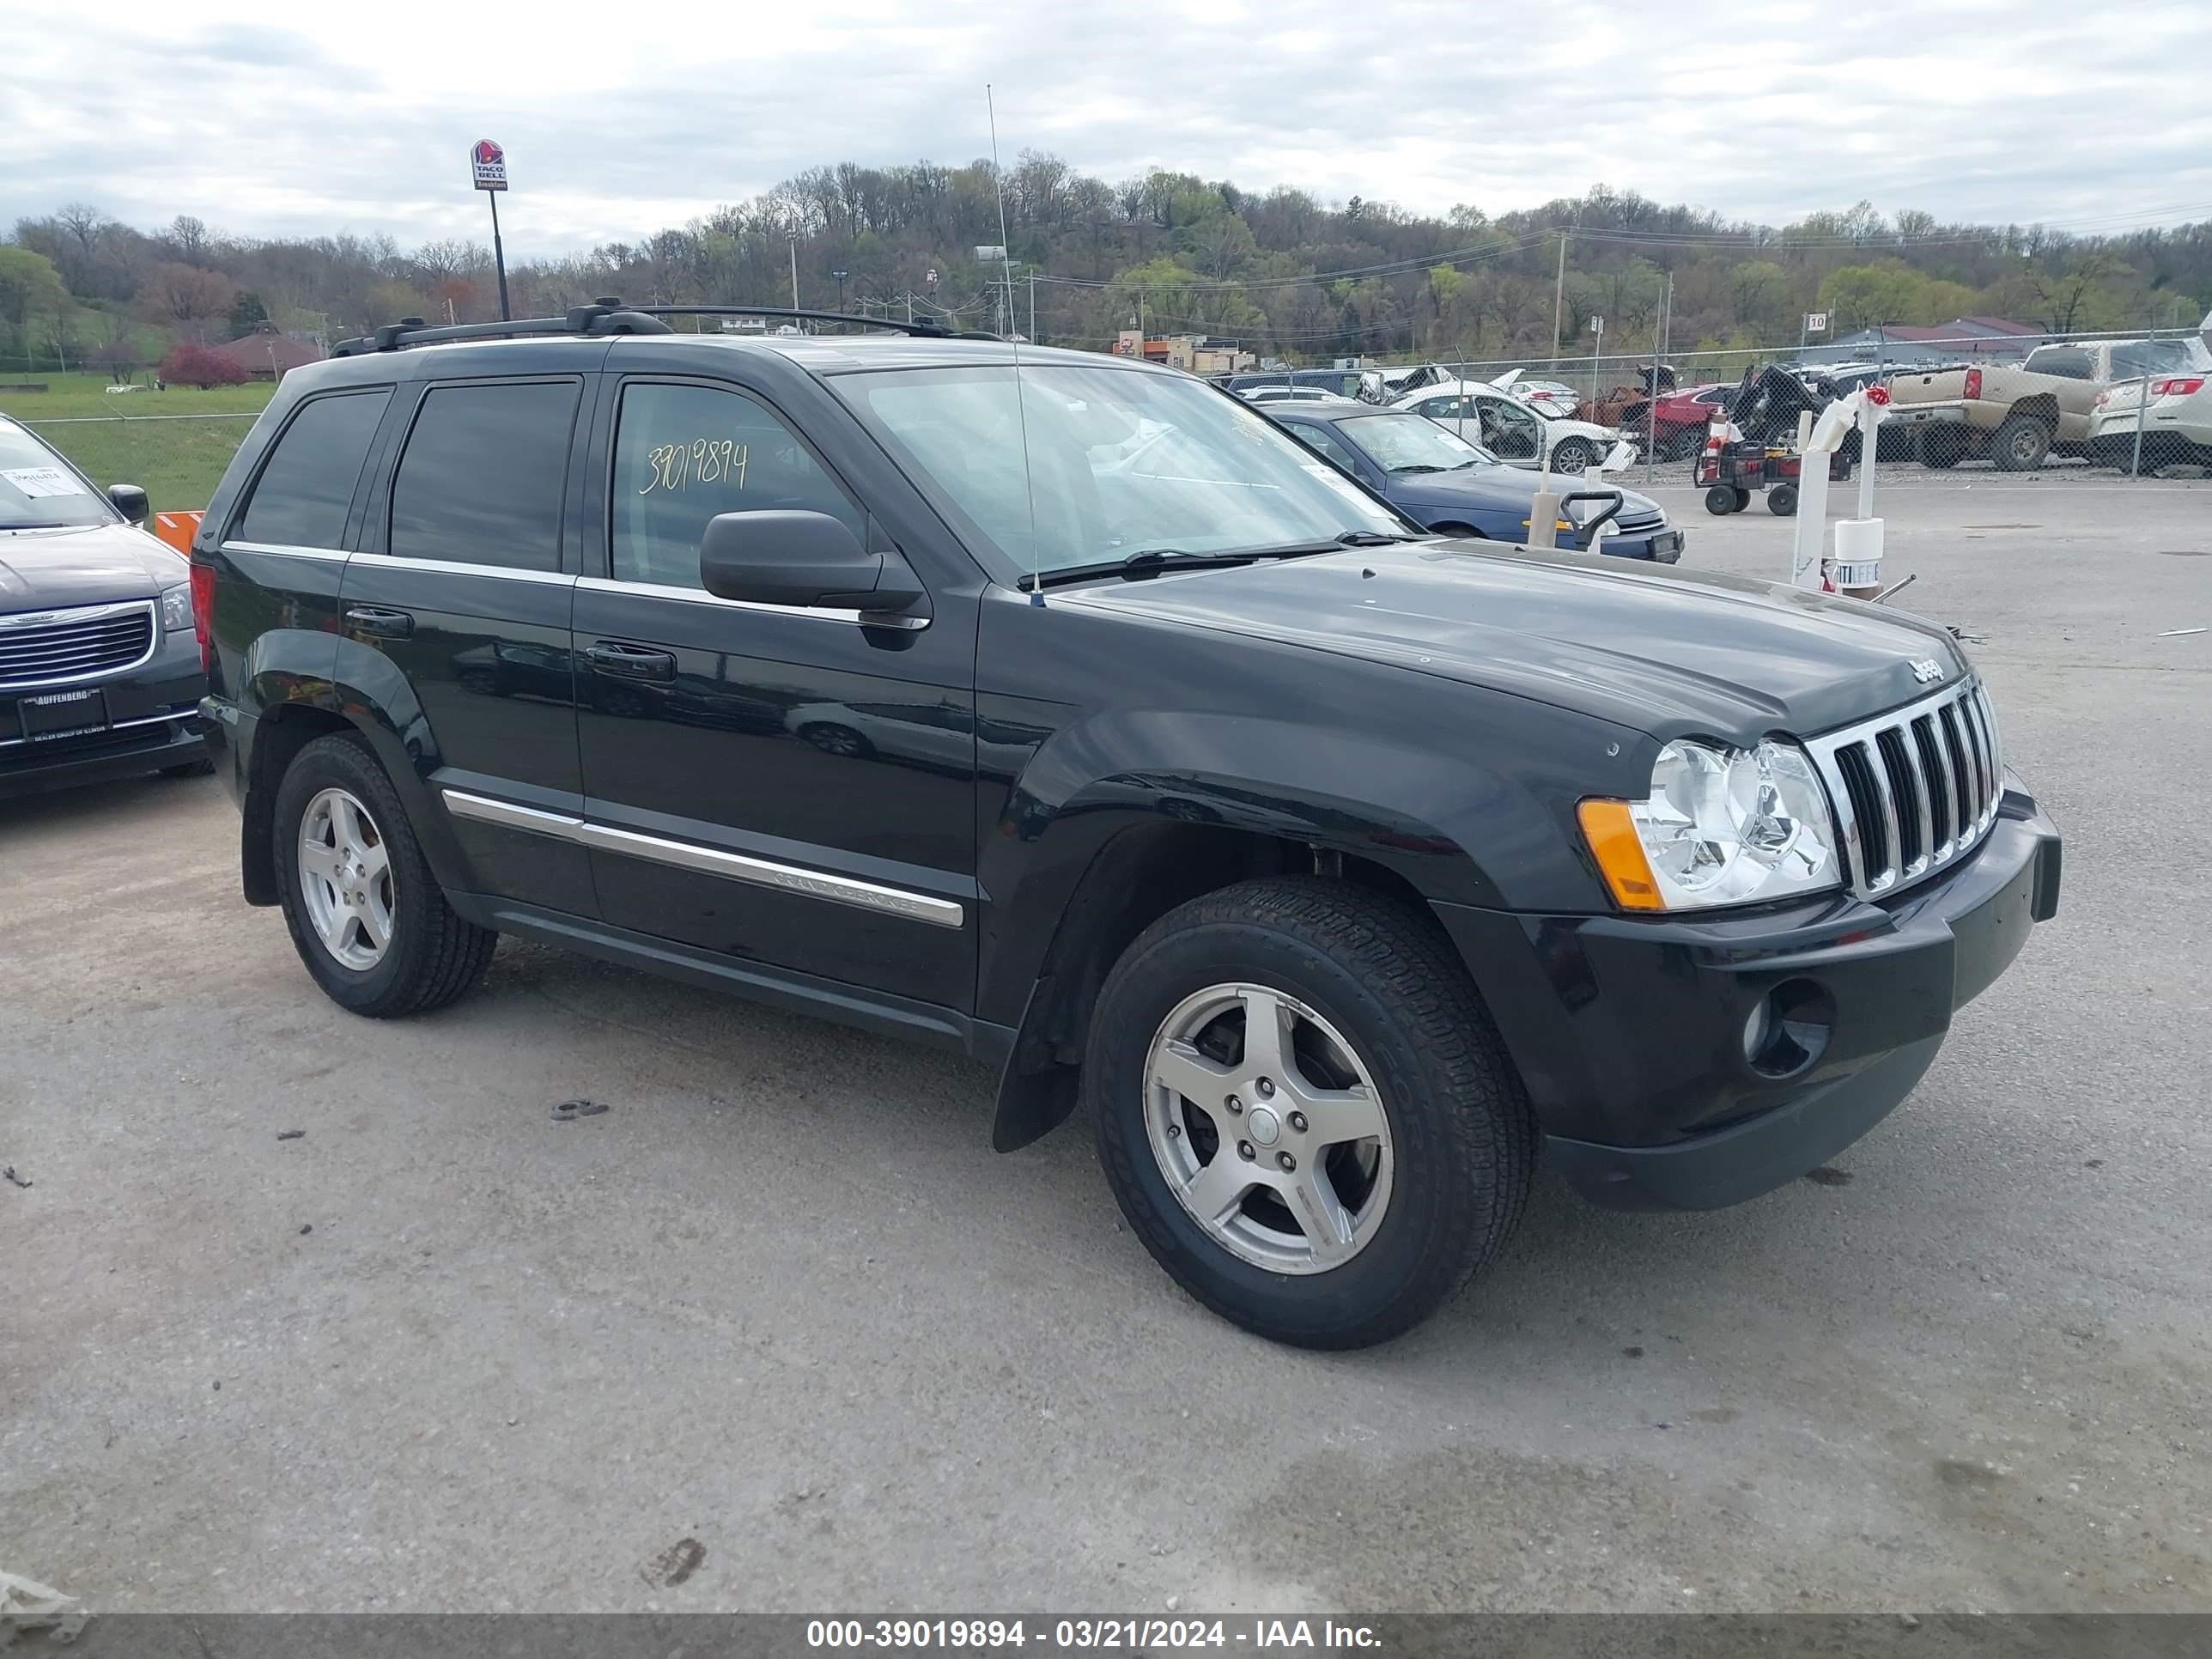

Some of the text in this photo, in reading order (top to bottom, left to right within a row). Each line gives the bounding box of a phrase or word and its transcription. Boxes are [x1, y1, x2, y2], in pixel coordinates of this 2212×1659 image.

[1811, 317, 1825, 327] 10
[638, 438, 748, 495] 39019894
[1908, 659, 1944, 683] Jeep
[833, 885, 920, 912] CHEROKEE
